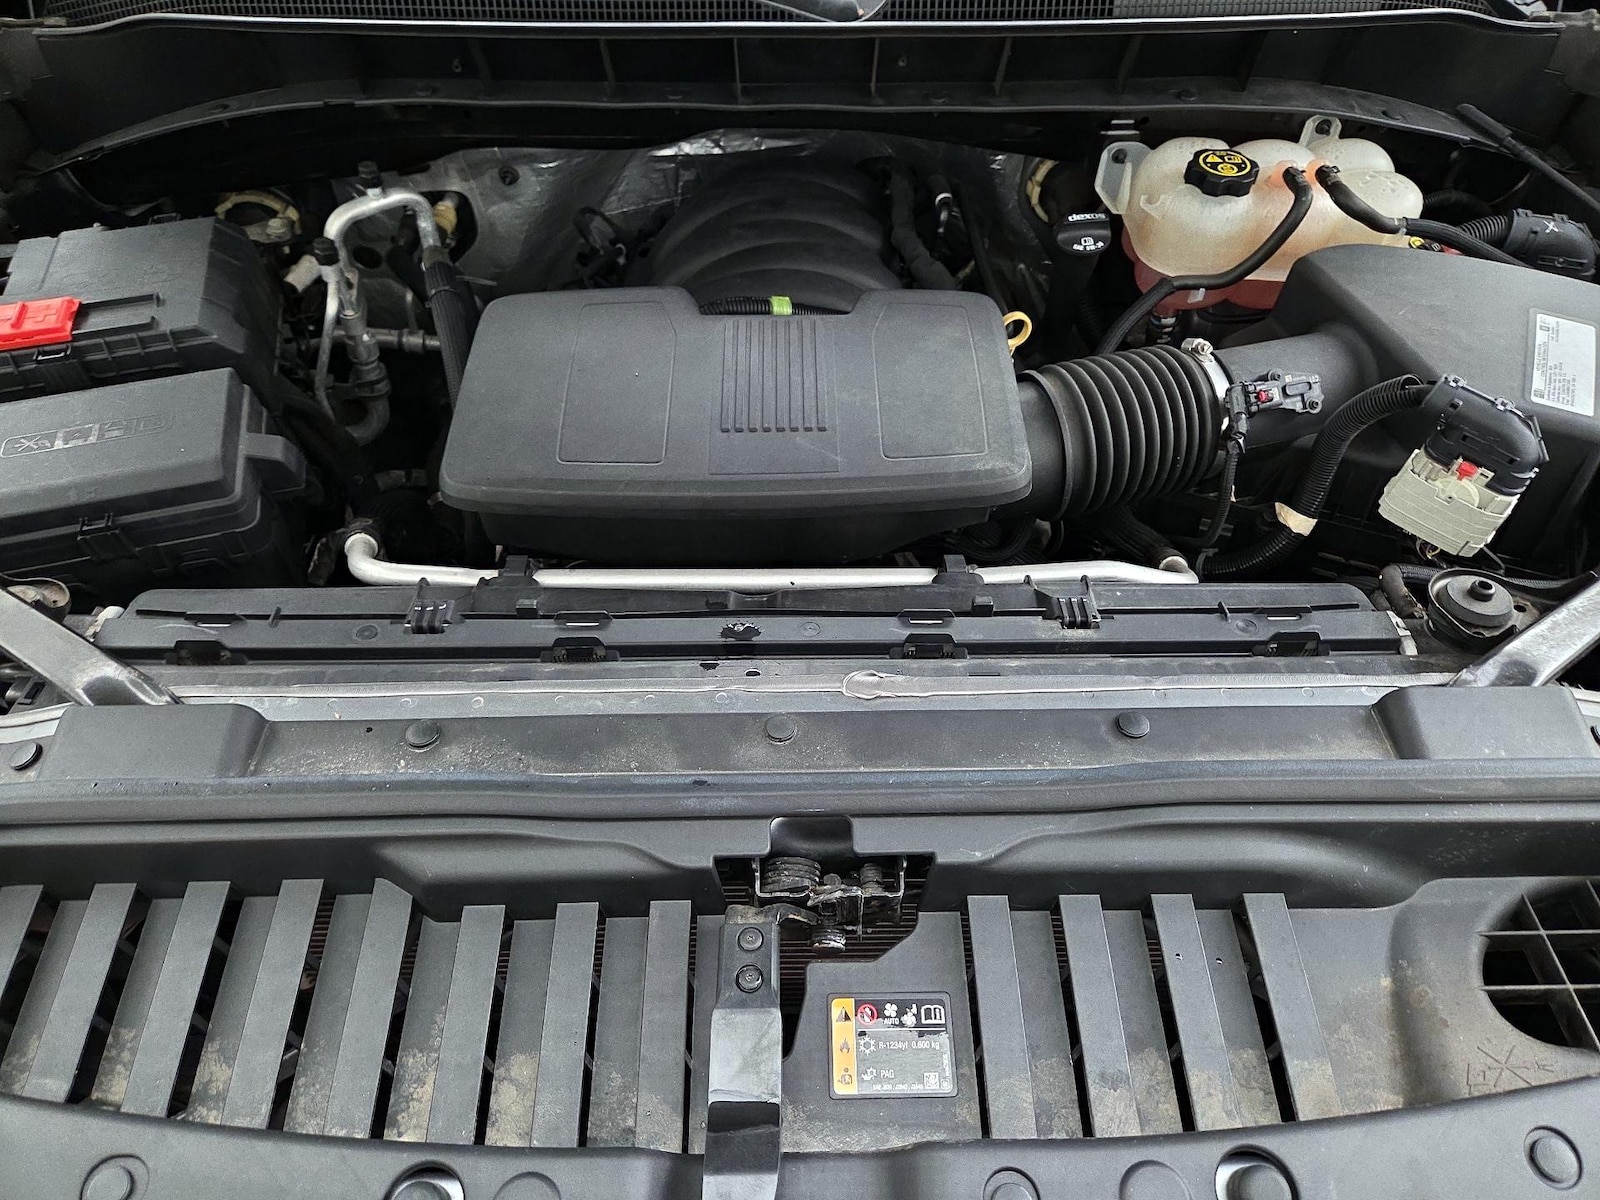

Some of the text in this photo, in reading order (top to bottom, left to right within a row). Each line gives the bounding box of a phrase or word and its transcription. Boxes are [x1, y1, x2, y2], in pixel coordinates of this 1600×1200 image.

[1068, 213, 1106, 221] dexos
[884, 1017, 900, 1025] AUTO
[878, 1040, 908, 1051] R-1234yf
[931, 1040, 940, 1050] kg
[880, 1069, 895, 1079] PAG
